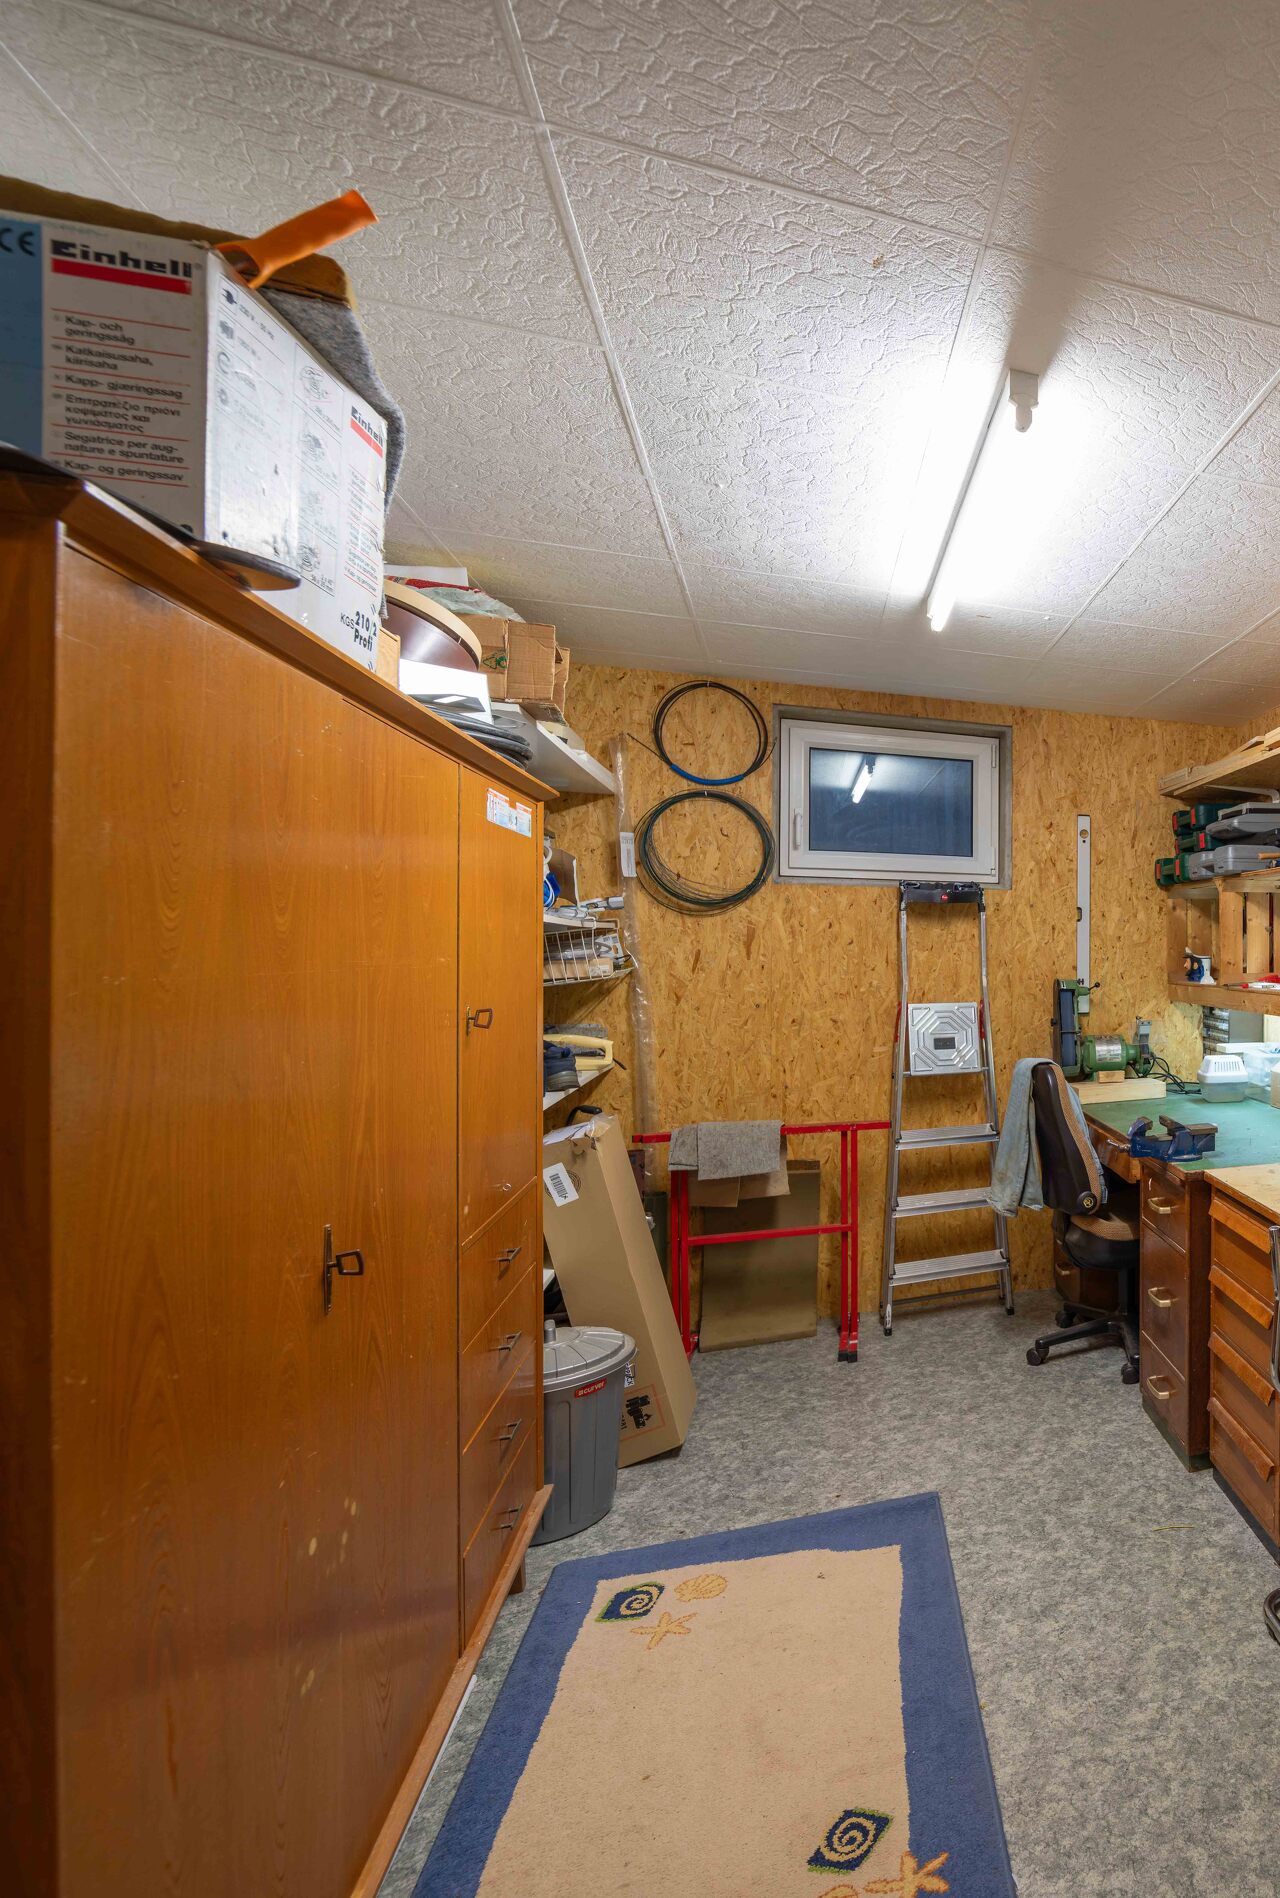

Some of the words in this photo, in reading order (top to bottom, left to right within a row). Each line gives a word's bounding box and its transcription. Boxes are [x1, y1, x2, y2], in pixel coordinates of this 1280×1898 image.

[51, 239, 192, 278] Einhell
[99, 321, 124, 332] och
[351, 405, 383, 448] Einhell
[64, 431, 124, 447] Segatrice
[127, 439, 149, 450] per
[98, 466, 114, 476] og
[354, 629, 373, 652] Profi
[583, 1381, 605, 1394] curver
